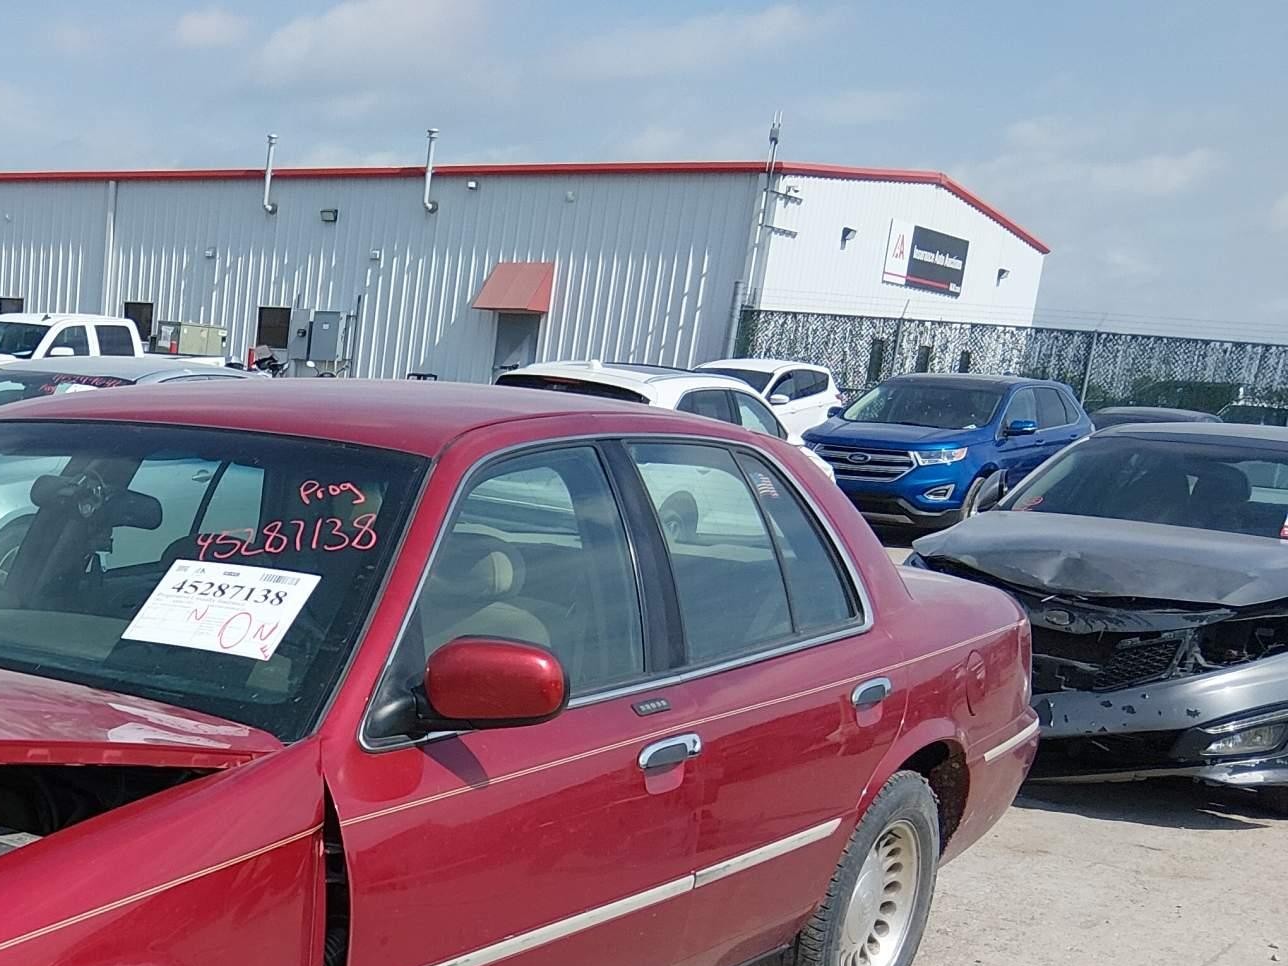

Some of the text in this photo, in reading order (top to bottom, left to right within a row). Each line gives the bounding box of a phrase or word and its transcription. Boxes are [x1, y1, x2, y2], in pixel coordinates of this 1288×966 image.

[300, 480, 366, 504] Prog
[197, 514, 377, 560] 45287138
[171, 579, 288, 606] 45287138
